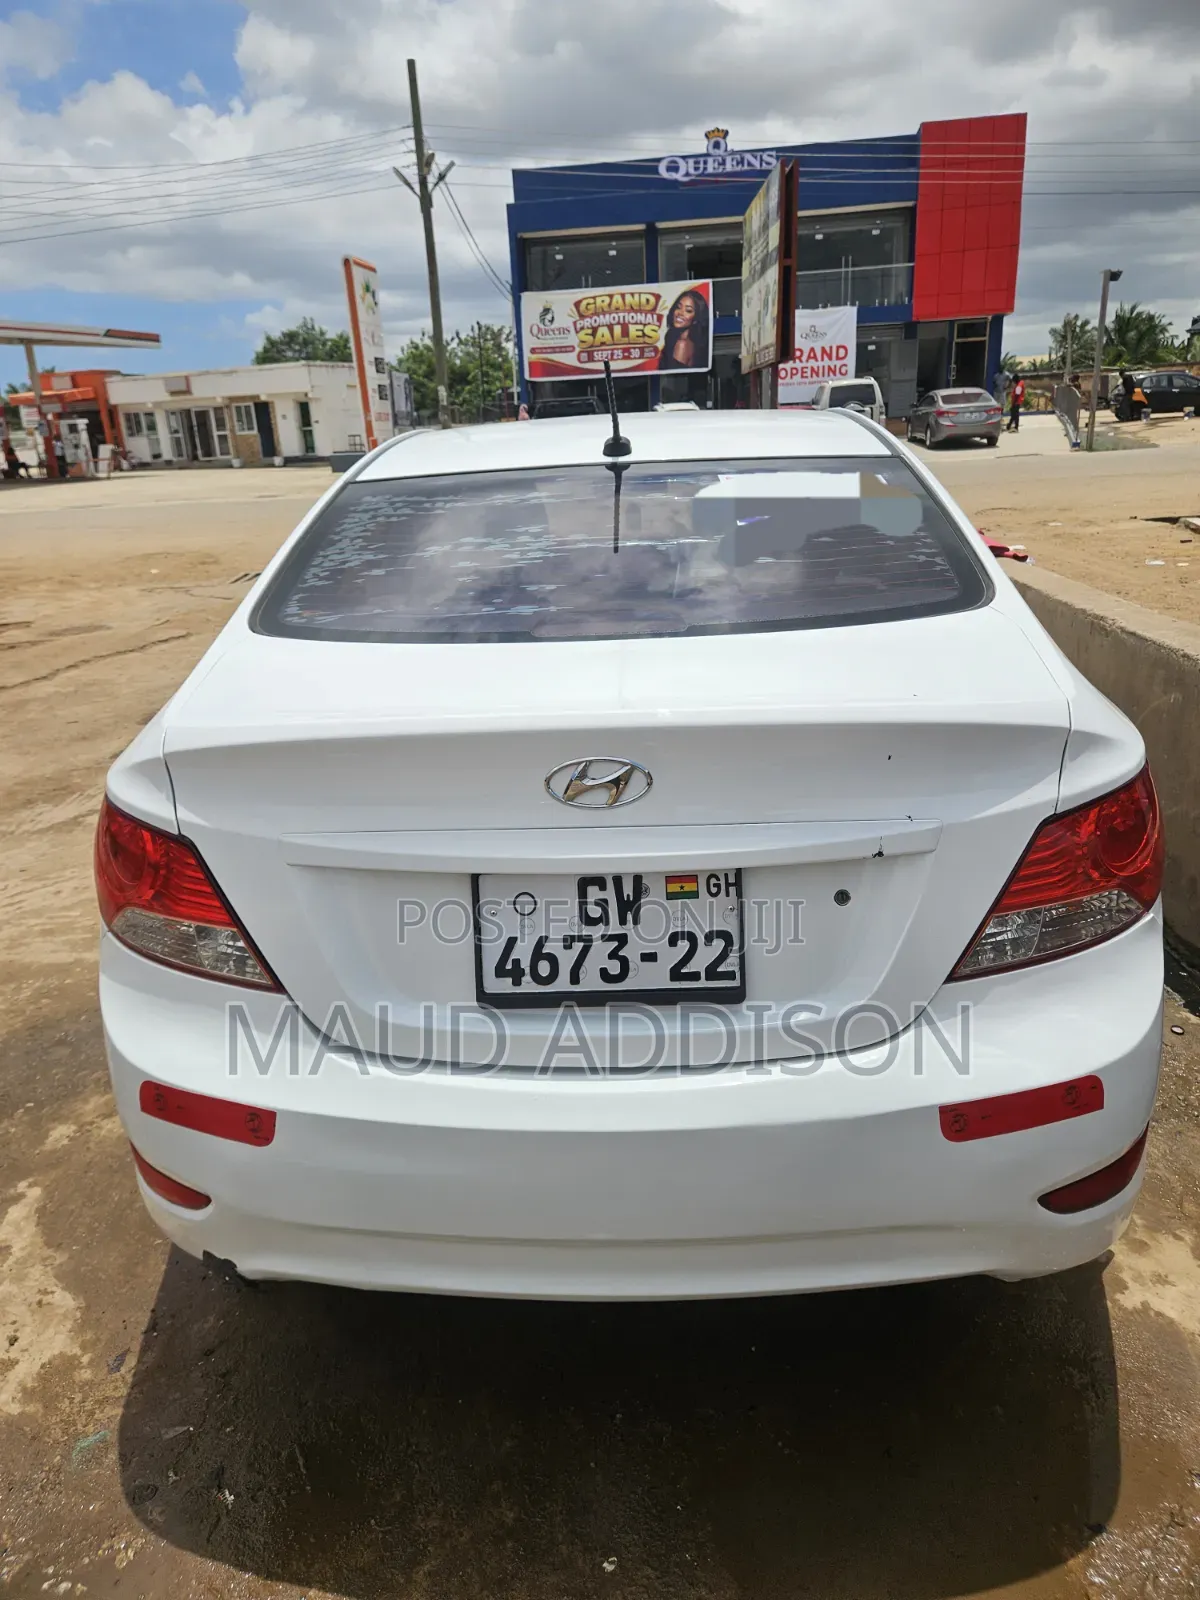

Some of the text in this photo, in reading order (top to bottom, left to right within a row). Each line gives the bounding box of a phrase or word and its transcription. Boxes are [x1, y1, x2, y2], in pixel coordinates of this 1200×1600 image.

[658, 150, 777, 181] QUEENS
[580, 293, 656, 316] GRAND
[529, 323, 571, 340] Queens
[576, 312, 660, 331] PROMOTIONAL
[577, 324, 660, 349] SALES
[593, 350, 611, 361] SEPT
[613, 349, 623, 359] 25
[630, 348, 640, 358] 30
[783, 344, 848, 364] RAND
[778, 363, 848, 380] OPENING
[706, 872, 737, 898] GH
[577, 874, 642, 926] GW
